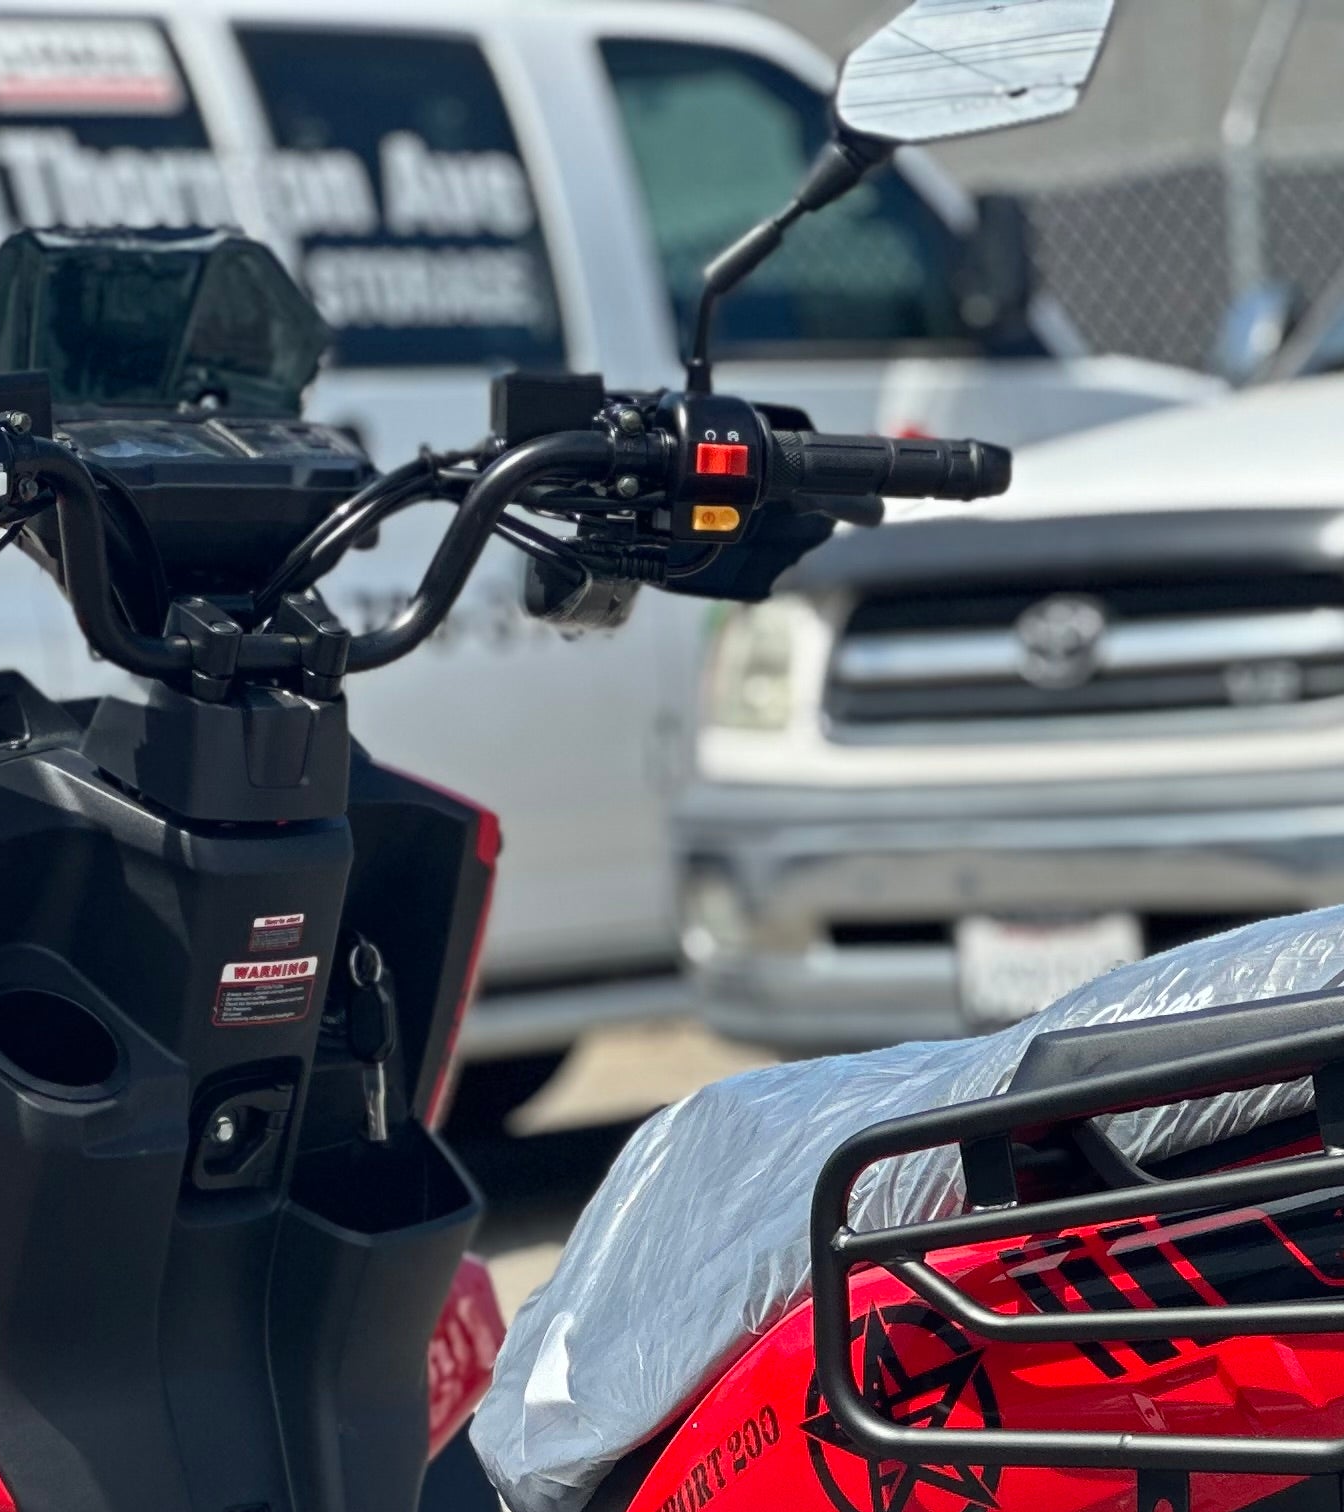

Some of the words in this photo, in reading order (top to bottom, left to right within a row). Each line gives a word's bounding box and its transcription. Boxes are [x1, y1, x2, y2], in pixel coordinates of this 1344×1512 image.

[378, 129, 535, 238] Ave
[234, 961, 309, 980] WARNING
[727, 1404, 782, 1474] 200
